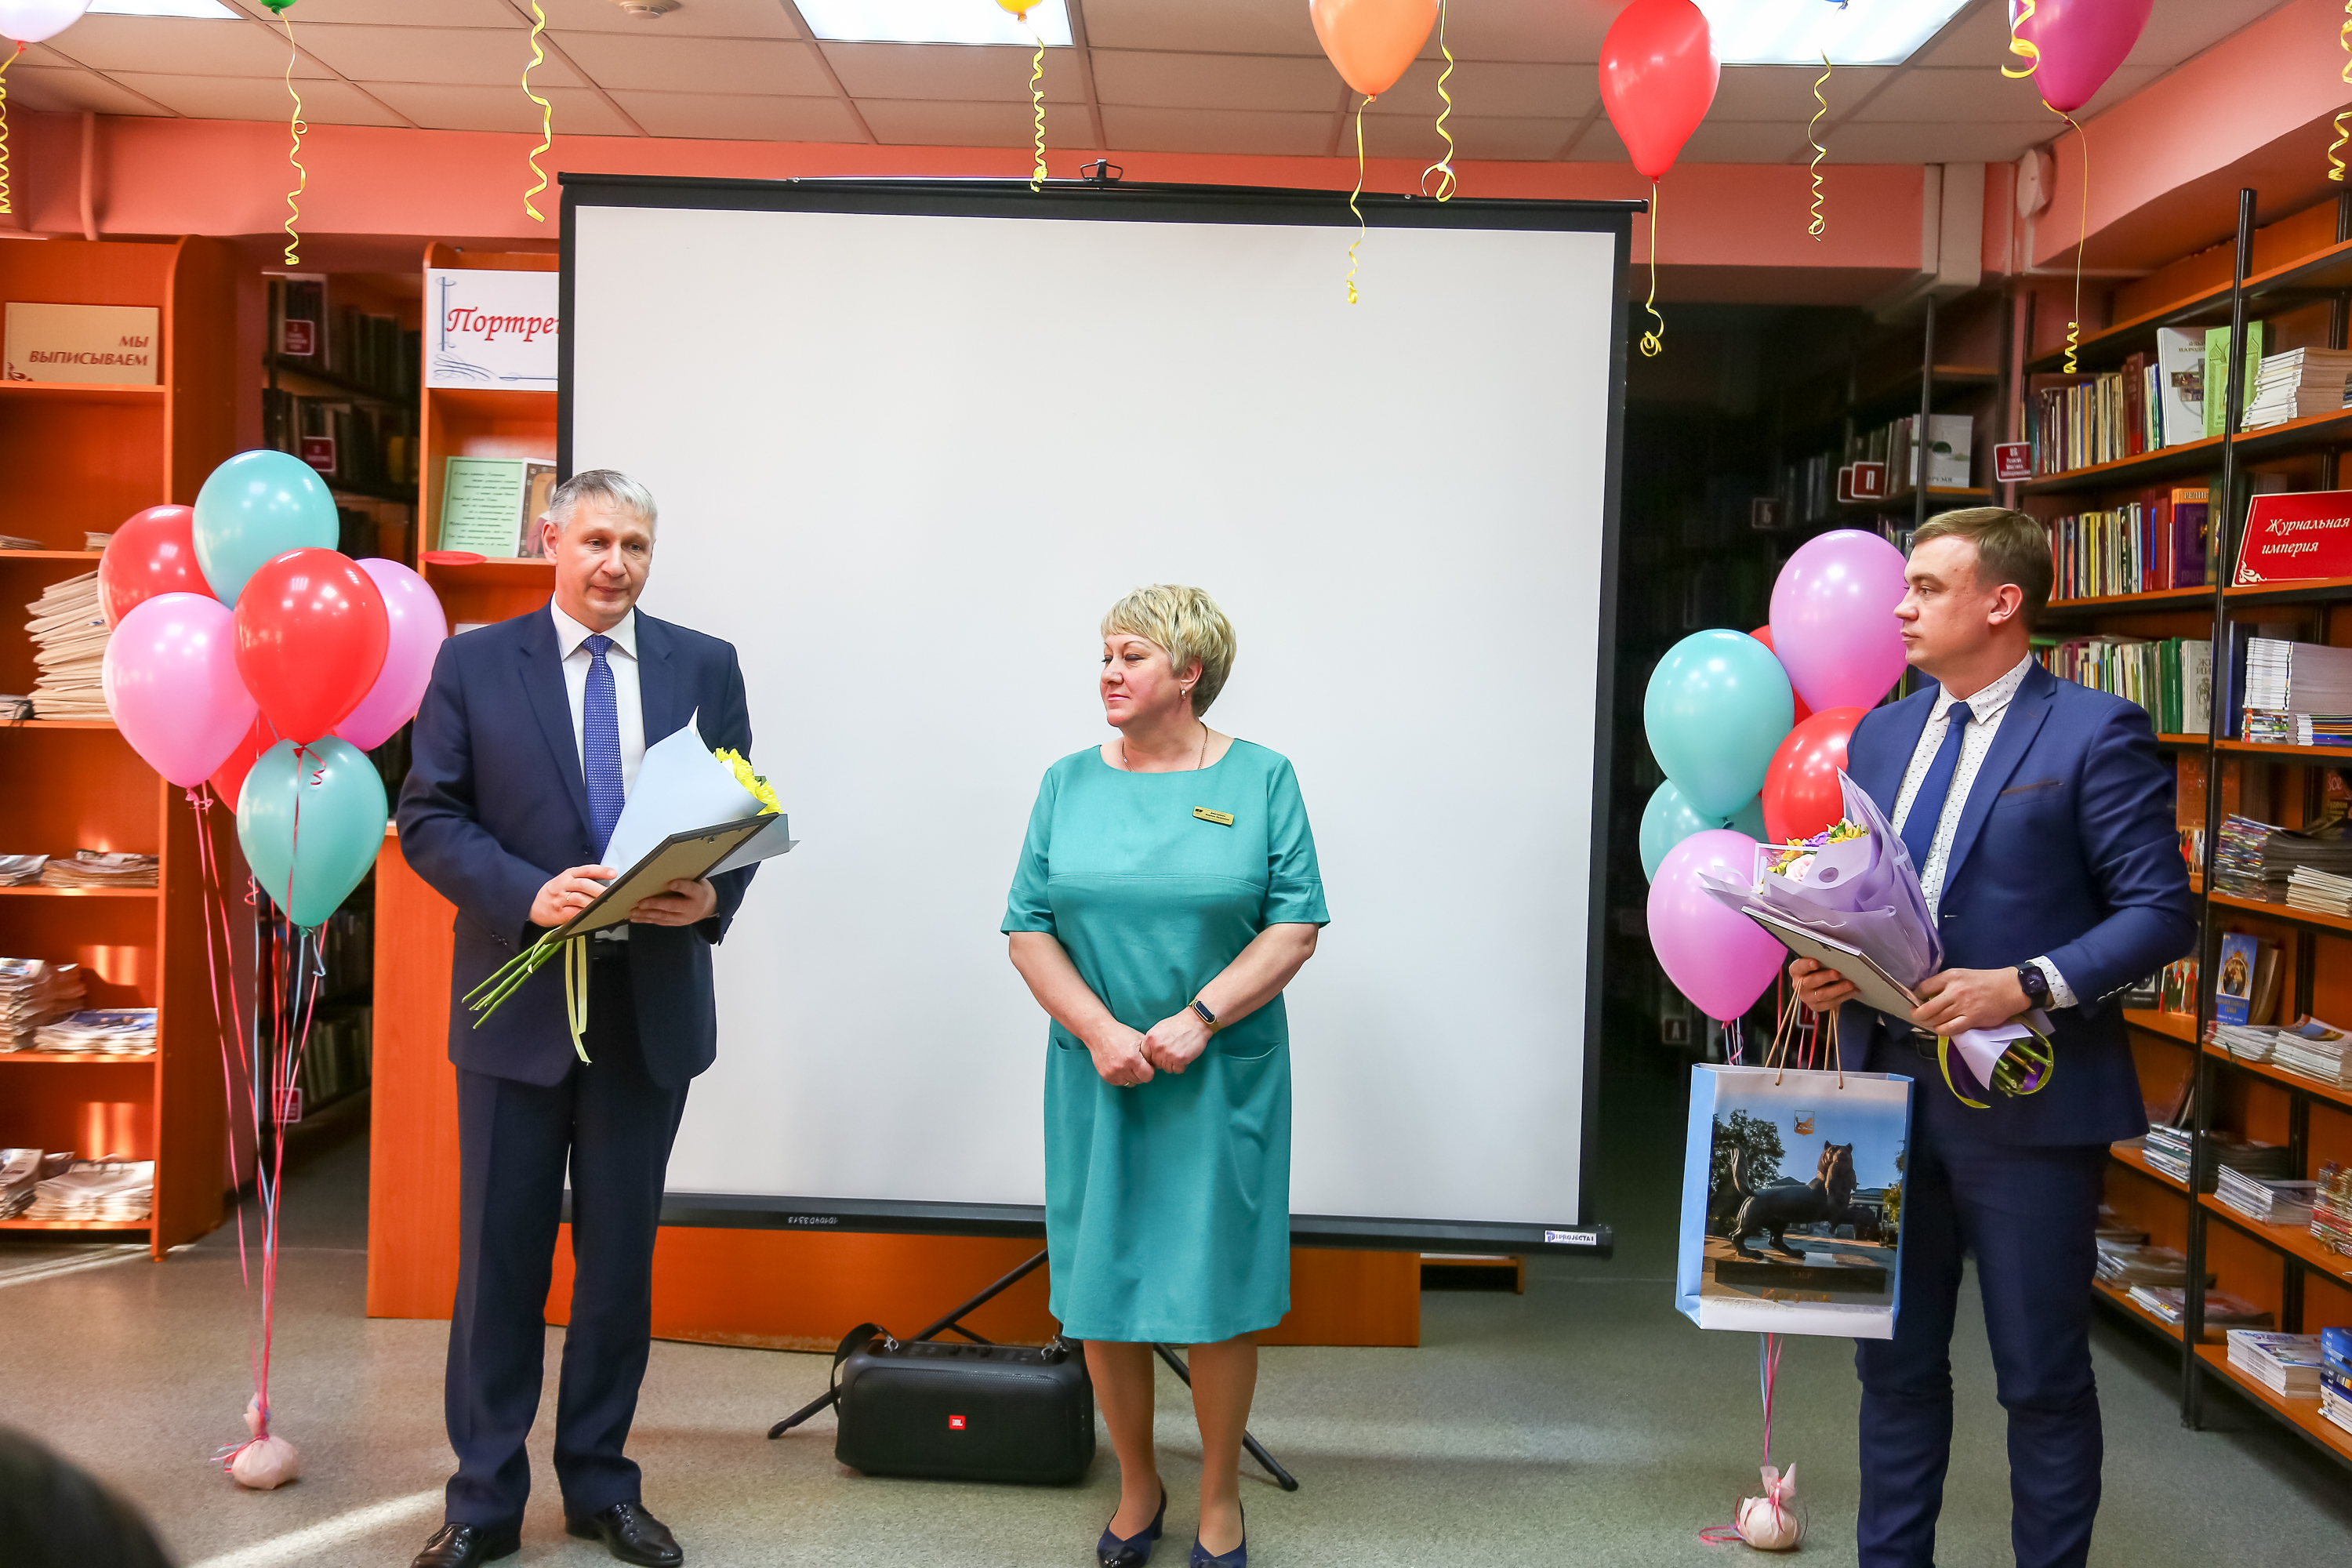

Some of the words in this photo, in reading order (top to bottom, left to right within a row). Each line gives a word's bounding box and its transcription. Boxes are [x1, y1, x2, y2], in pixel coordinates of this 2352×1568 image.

[118, 336, 149, 347] МЫ
[29, 350, 149, 366] ВЫПИСЫВАЕМ
[2264, 517, 2350, 536] Журнальная
[2261, 542, 2319, 557] империя
[952, 1418, 964, 1427] JBL
